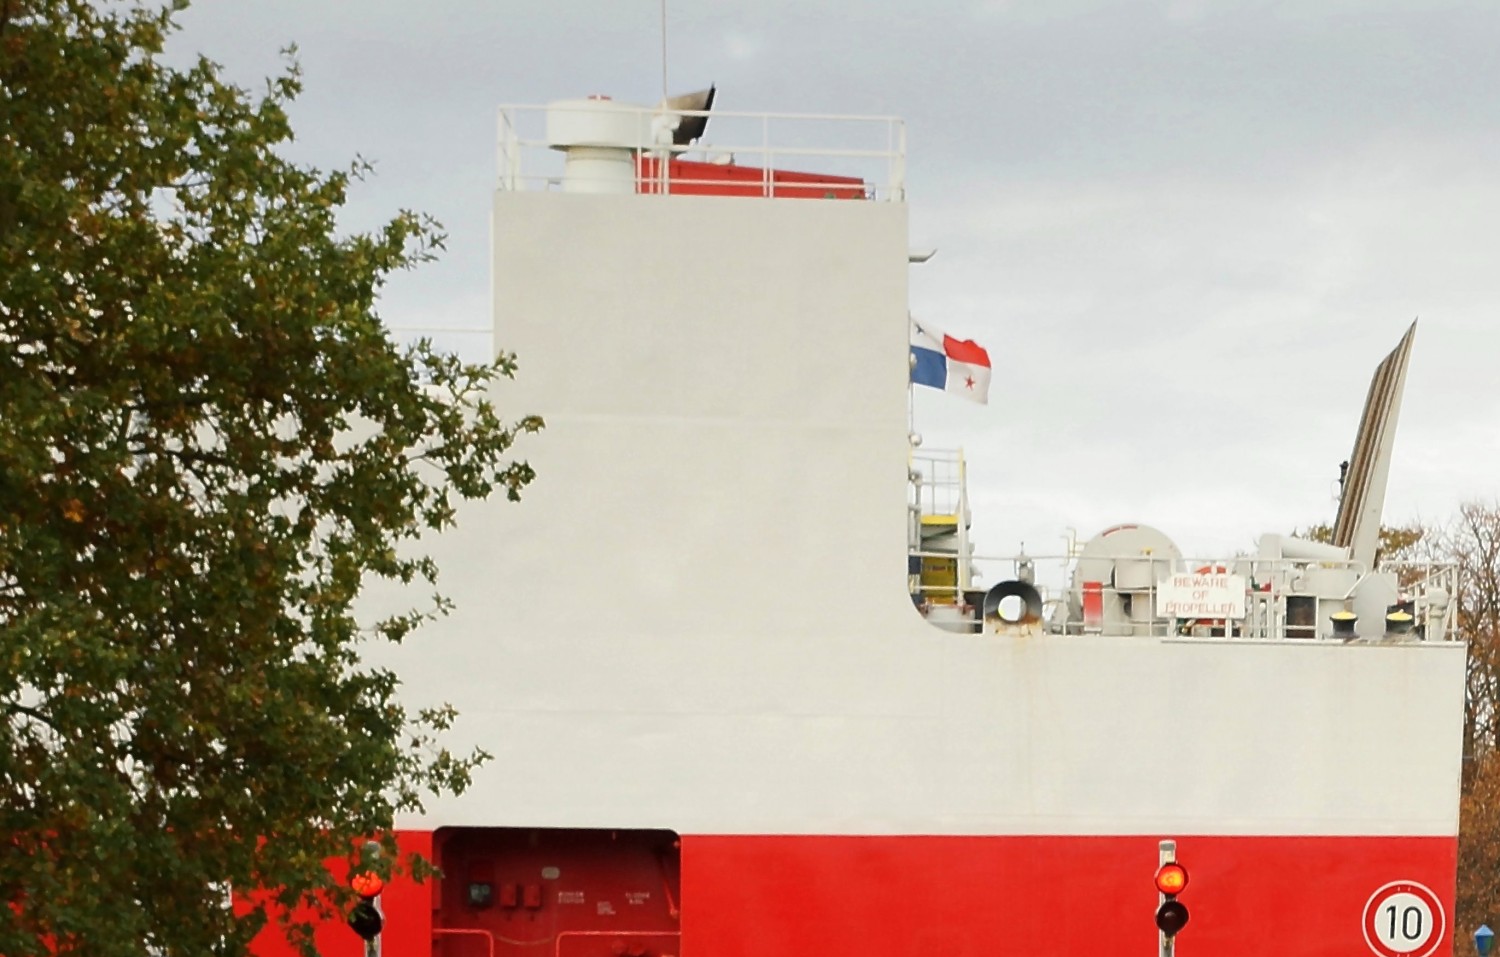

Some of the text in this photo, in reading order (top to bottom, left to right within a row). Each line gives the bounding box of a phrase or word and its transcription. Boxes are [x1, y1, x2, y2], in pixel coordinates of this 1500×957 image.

[1173, 577, 1227, 588] BEWARE
[1192, 590, 1208, 600] OF
[1165, 602, 1236, 614] PROPELLER
[1386, 905, 1423, 940] 10
